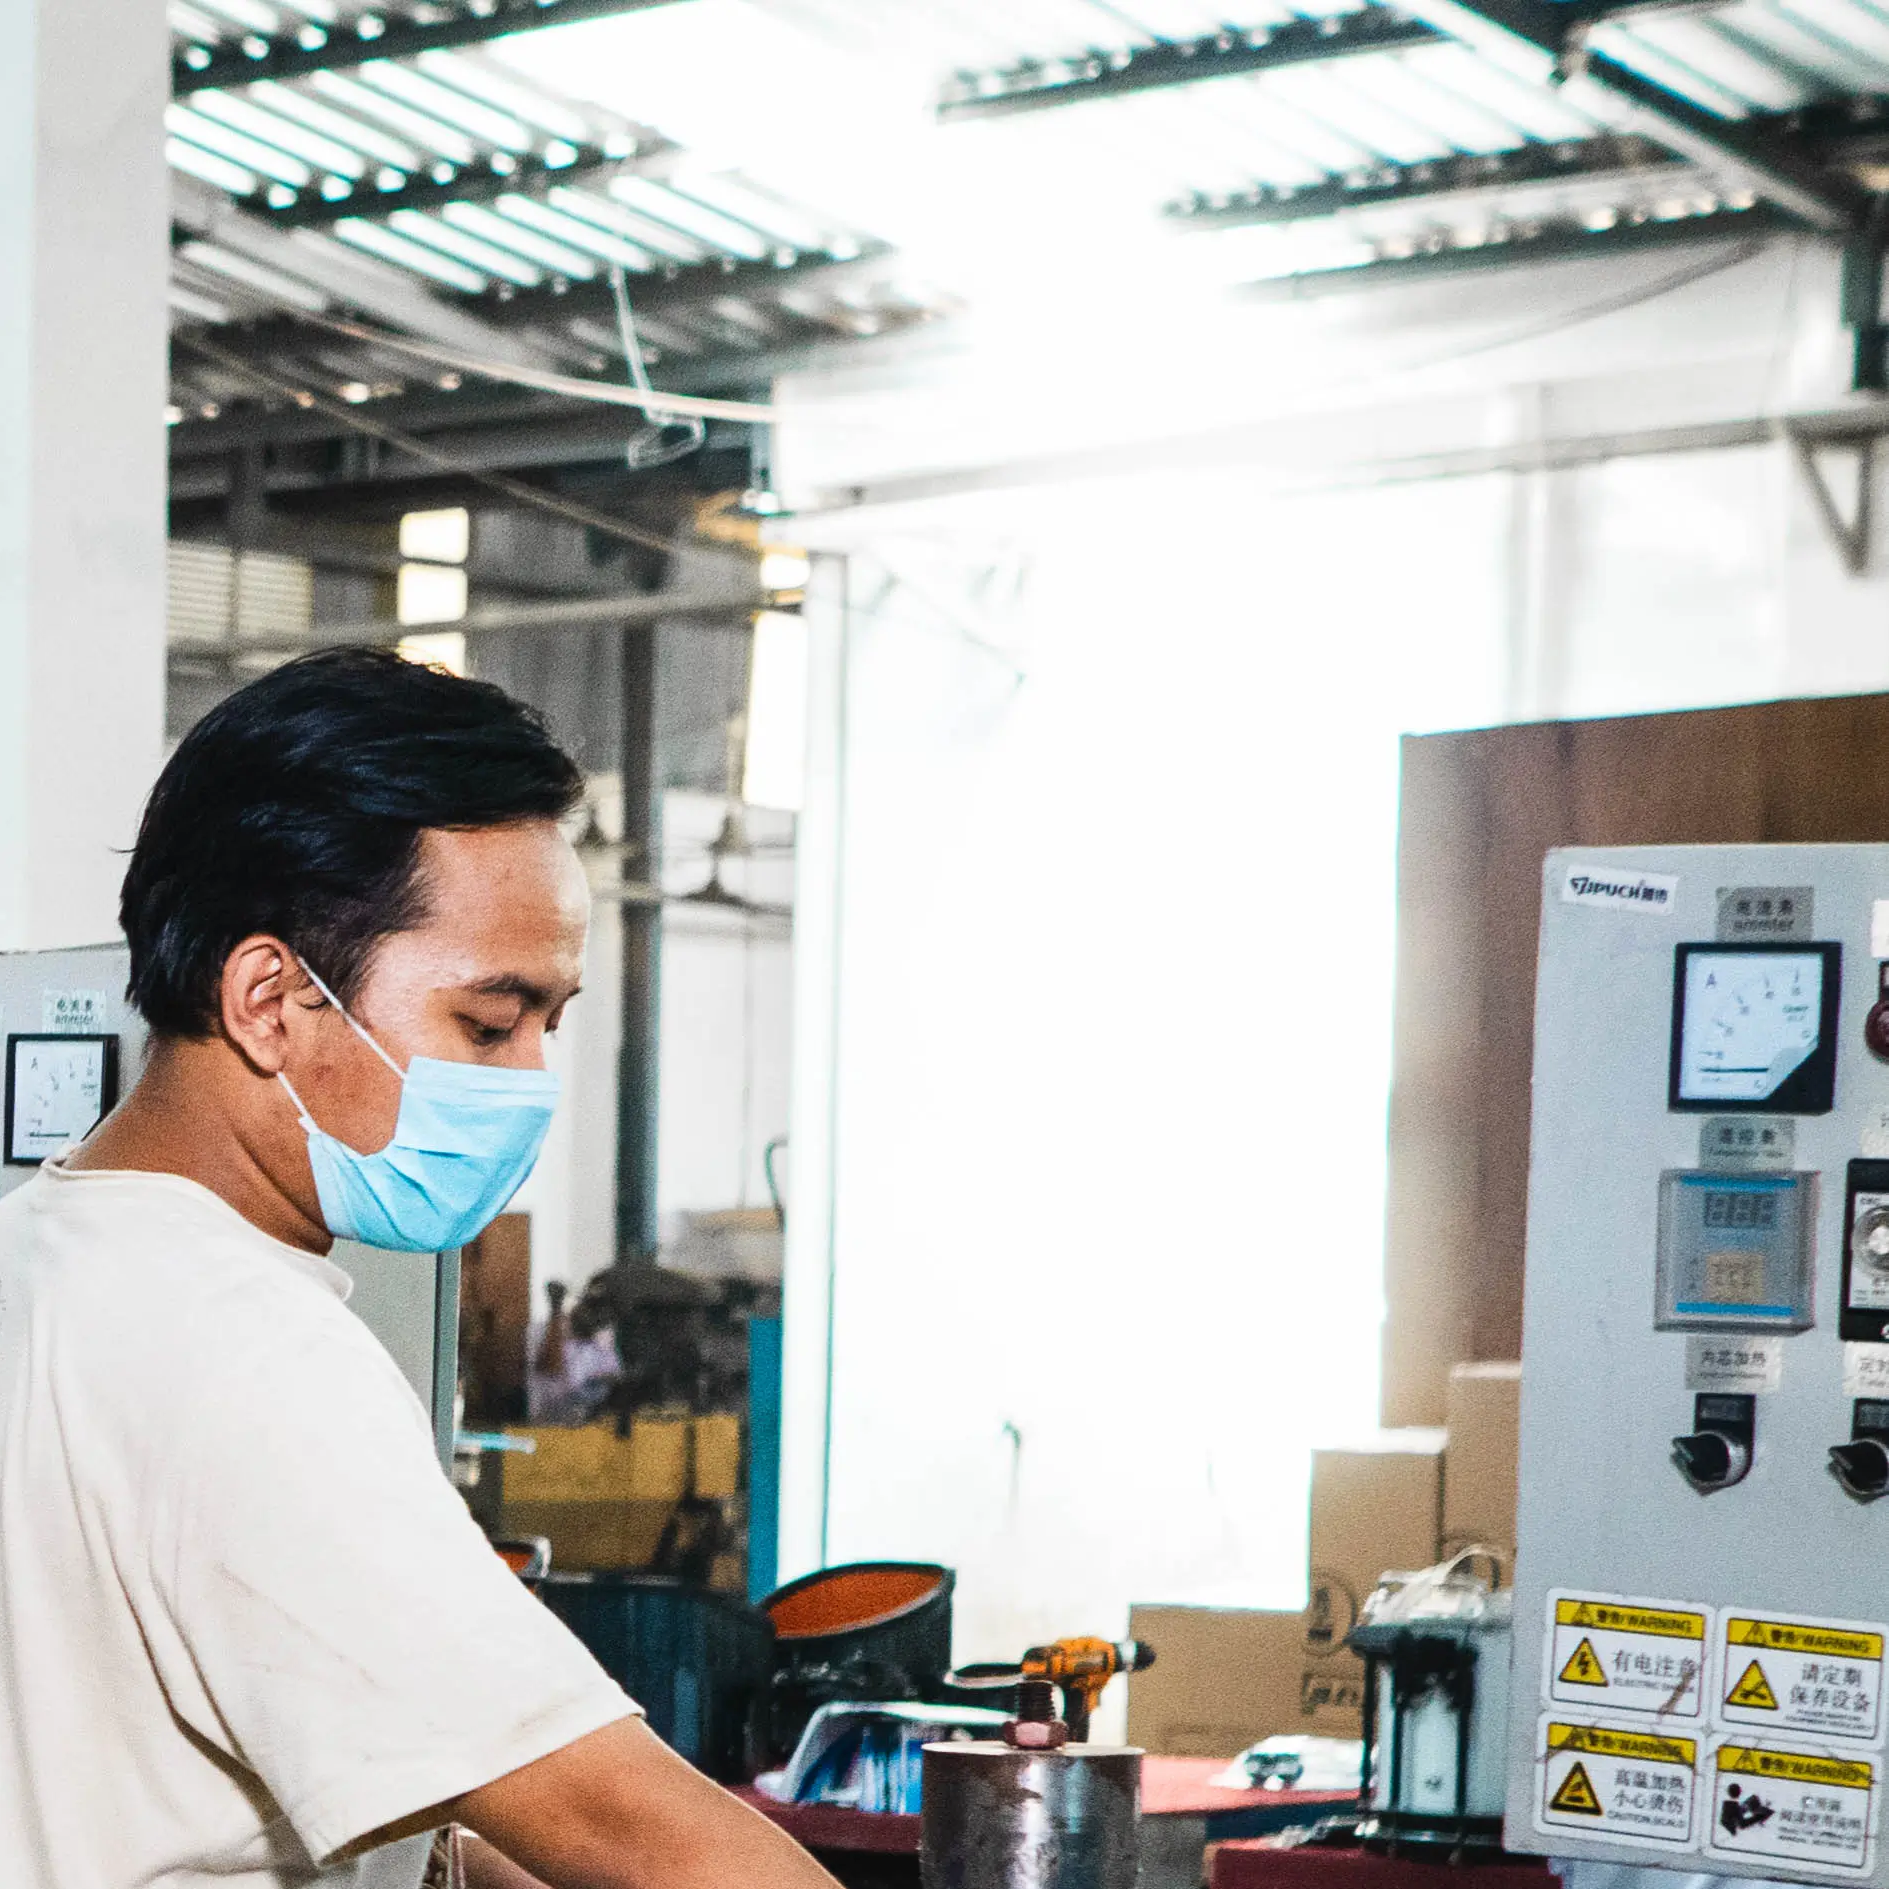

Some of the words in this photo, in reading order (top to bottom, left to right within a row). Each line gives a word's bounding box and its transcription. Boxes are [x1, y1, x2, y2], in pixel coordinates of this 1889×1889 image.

[1612, 1649, 1698, 1678] 有电注意
[1614, 1768, 1686, 1793] 高温加热
